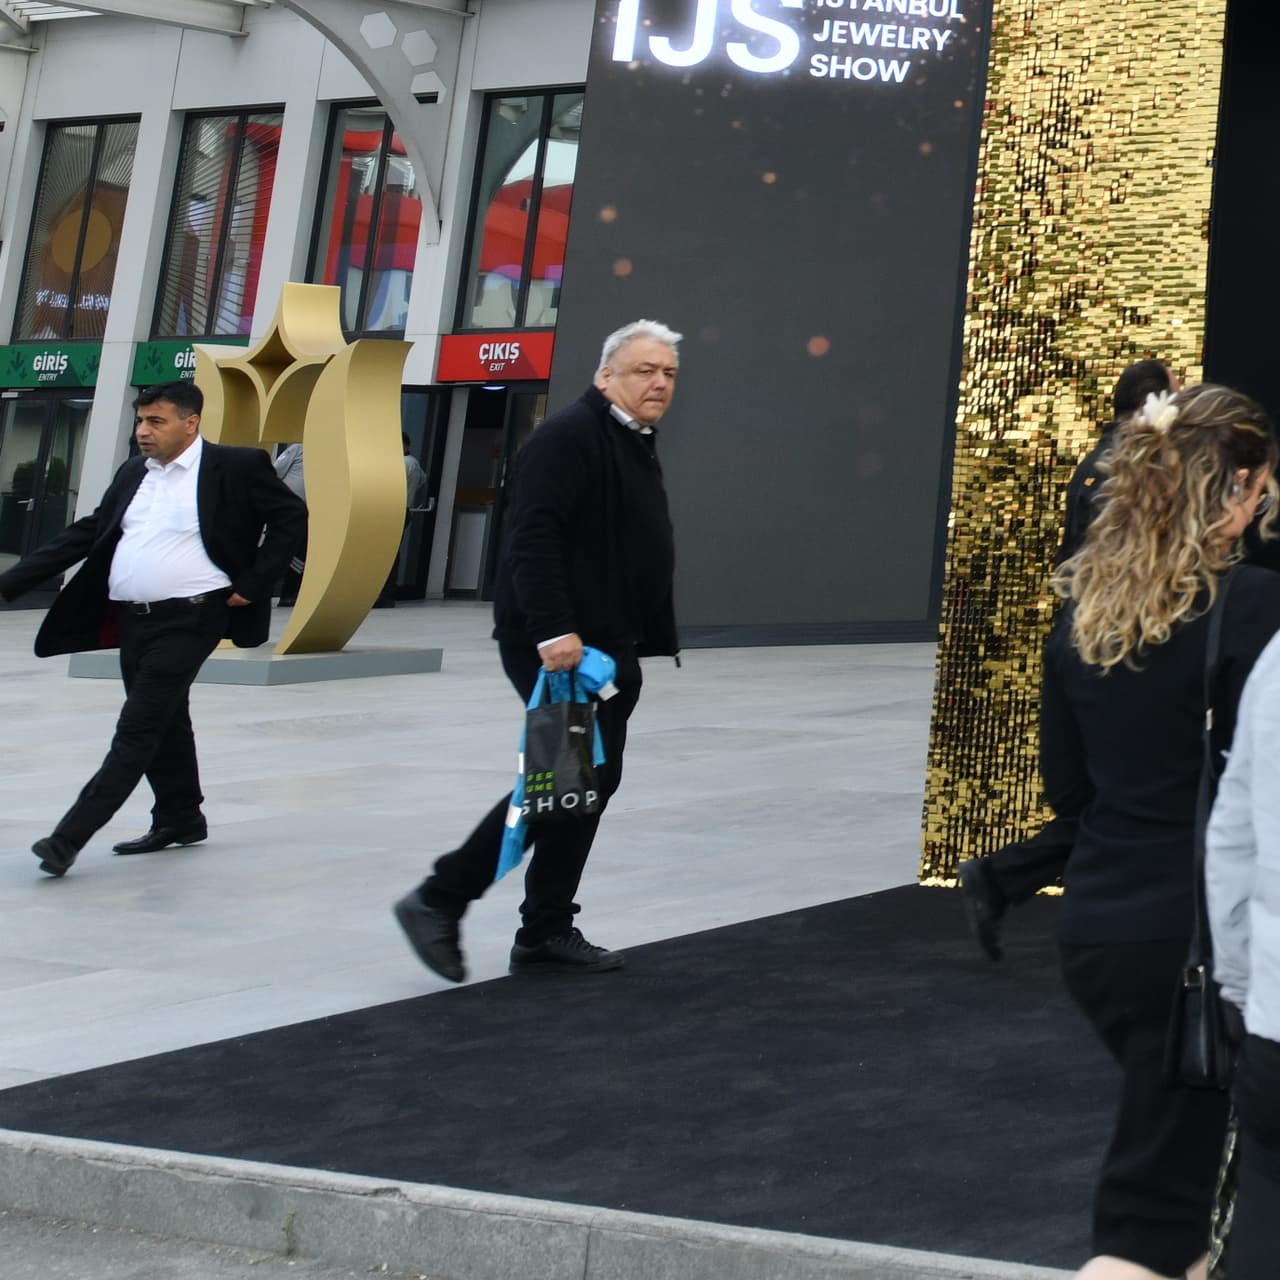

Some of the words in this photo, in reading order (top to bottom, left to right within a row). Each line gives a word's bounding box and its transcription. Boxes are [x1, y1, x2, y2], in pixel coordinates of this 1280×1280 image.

[812, 19, 952, 52] JEWELRY
[809, 53, 911, 83] SHOW
[174, 347, 197, 368] GİR
[479, 342, 520, 365] ÇIKIŞ
[38, 373, 58, 382] ENTRY
[489, 362, 506, 372] EXIT
[521, 789, 599, 816] SHOP
